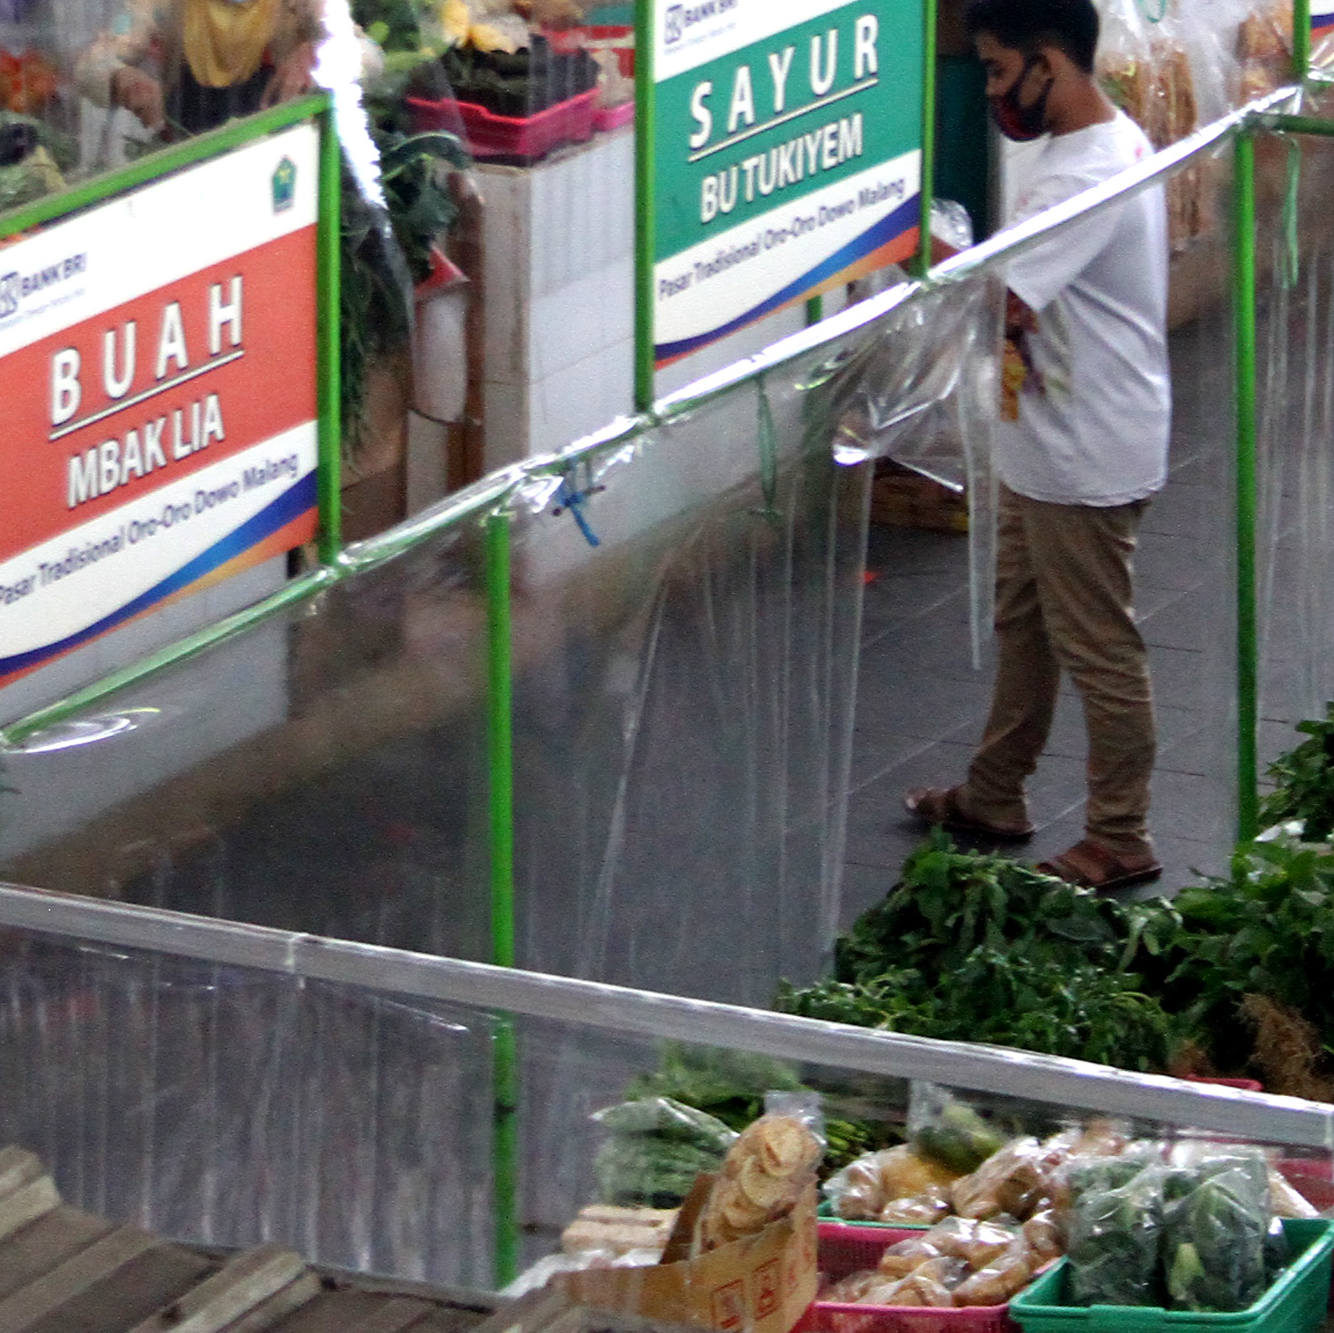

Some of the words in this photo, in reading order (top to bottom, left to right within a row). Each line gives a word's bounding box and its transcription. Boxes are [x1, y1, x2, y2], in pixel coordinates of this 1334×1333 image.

[685, 2, 716, 27] BANK
[689, 15, 879, 149] SAYUR
[700, 164, 738, 224] BU
[742, 112, 863, 203] TUKIYEM
[21, 262, 60, 297] BANK
[63, 252, 87, 280] BRI
[658, 268, 691, 301] Pasar
[694, 234, 761, 283] Tradisional
[764, 214, 816, 250] Oro-Oro
[818, 198, 855, 226] Dowo
[857, 177, 905, 210] Malang
[51, 274, 243, 427] BUAH
[68, 416, 167, 509] MBAK
[172, 392, 225, 461] LIA
[39, 527, 127, 588] Tradisional
[128, 502, 192, 543] Oro-Oro
[195, 481, 240, 515] Dowo
[242, 452, 300, 492] Malang
